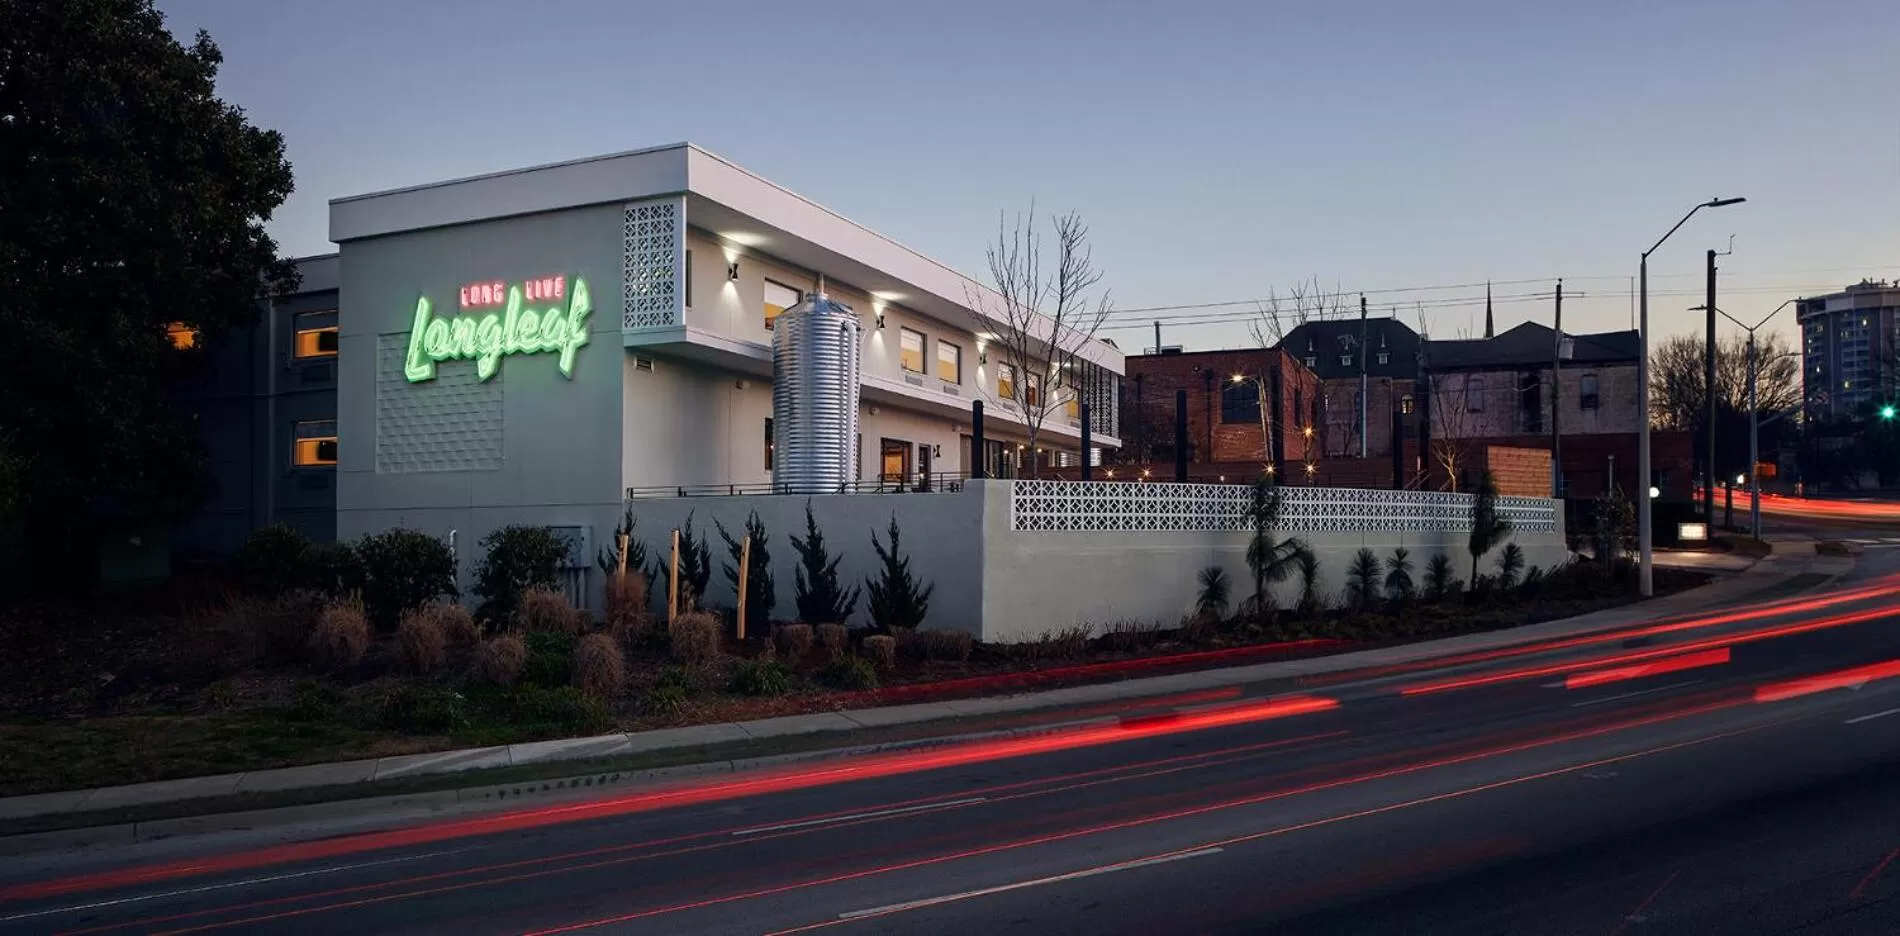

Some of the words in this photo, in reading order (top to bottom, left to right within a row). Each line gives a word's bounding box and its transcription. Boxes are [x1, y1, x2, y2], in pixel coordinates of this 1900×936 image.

[461, 283, 504, 306] LONG
[525, 276, 565, 300] LIVE
[405, 276, 590, 382] Longleaf
